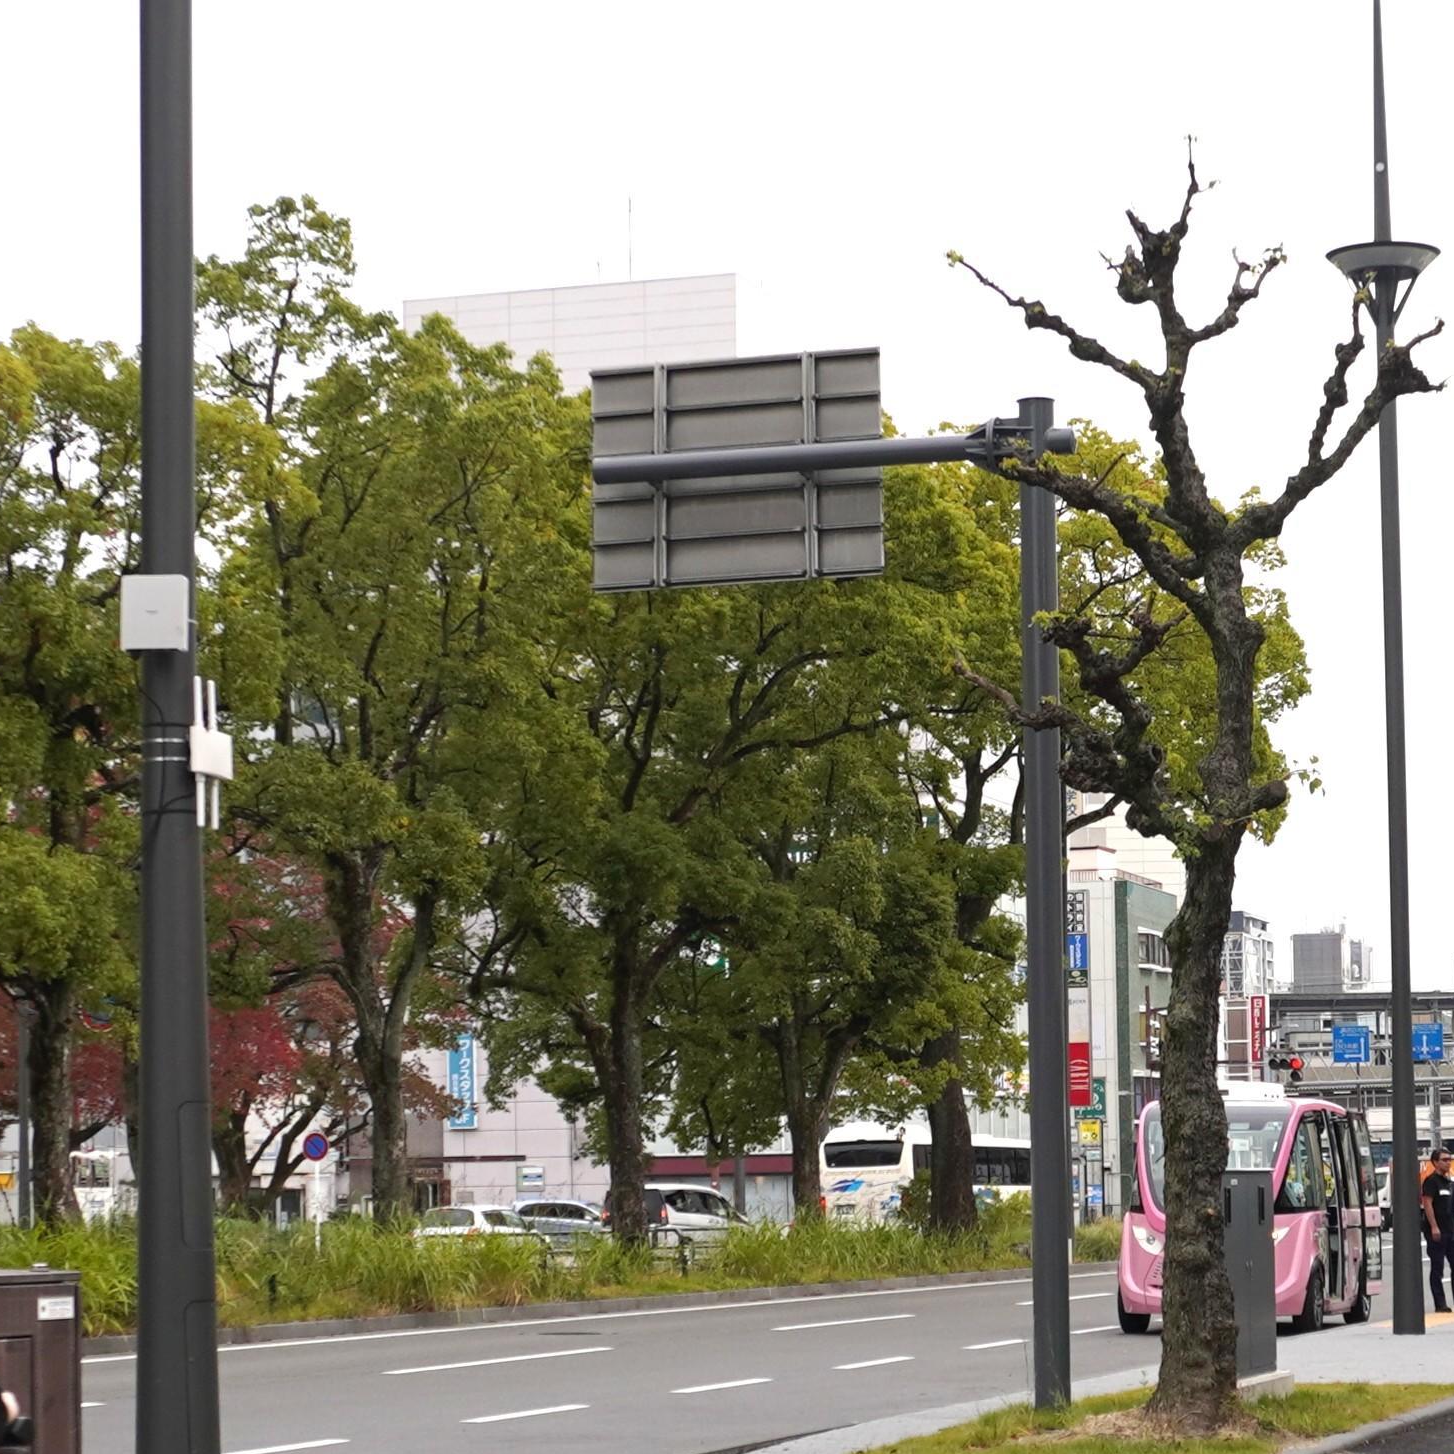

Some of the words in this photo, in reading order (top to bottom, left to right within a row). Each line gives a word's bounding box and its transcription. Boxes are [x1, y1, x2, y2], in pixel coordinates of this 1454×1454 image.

[458, 1039, 472, 1112] ワークスタッフ
